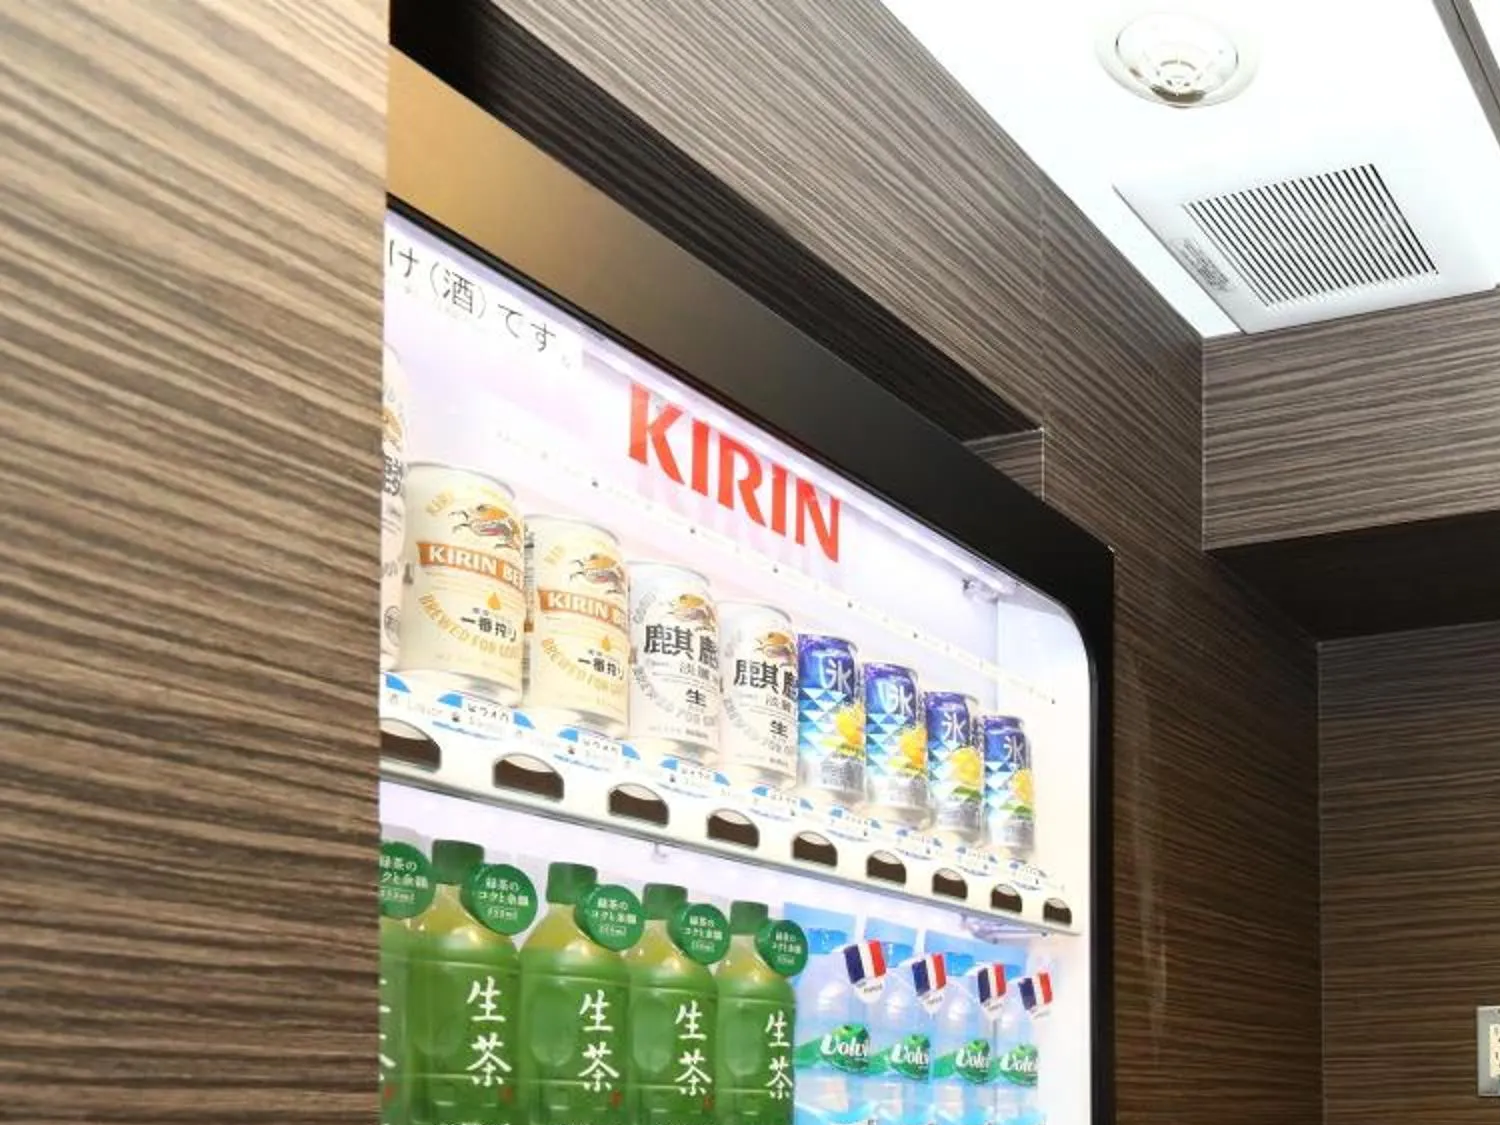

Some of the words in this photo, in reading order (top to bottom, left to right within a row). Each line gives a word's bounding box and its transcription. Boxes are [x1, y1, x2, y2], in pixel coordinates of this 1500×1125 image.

[628, 382, 841, 563] KIRIN
[430, 545, 497, 577] KIRIN
[548, 591, 609, 620] KIRIN
[466, 976, 512, 1087] 生茶
[578, 989, 620, 1092] 生茶
[675, 1000, 713, 1096] 生茶
[765, 1009, 793, 1100] 生茶
